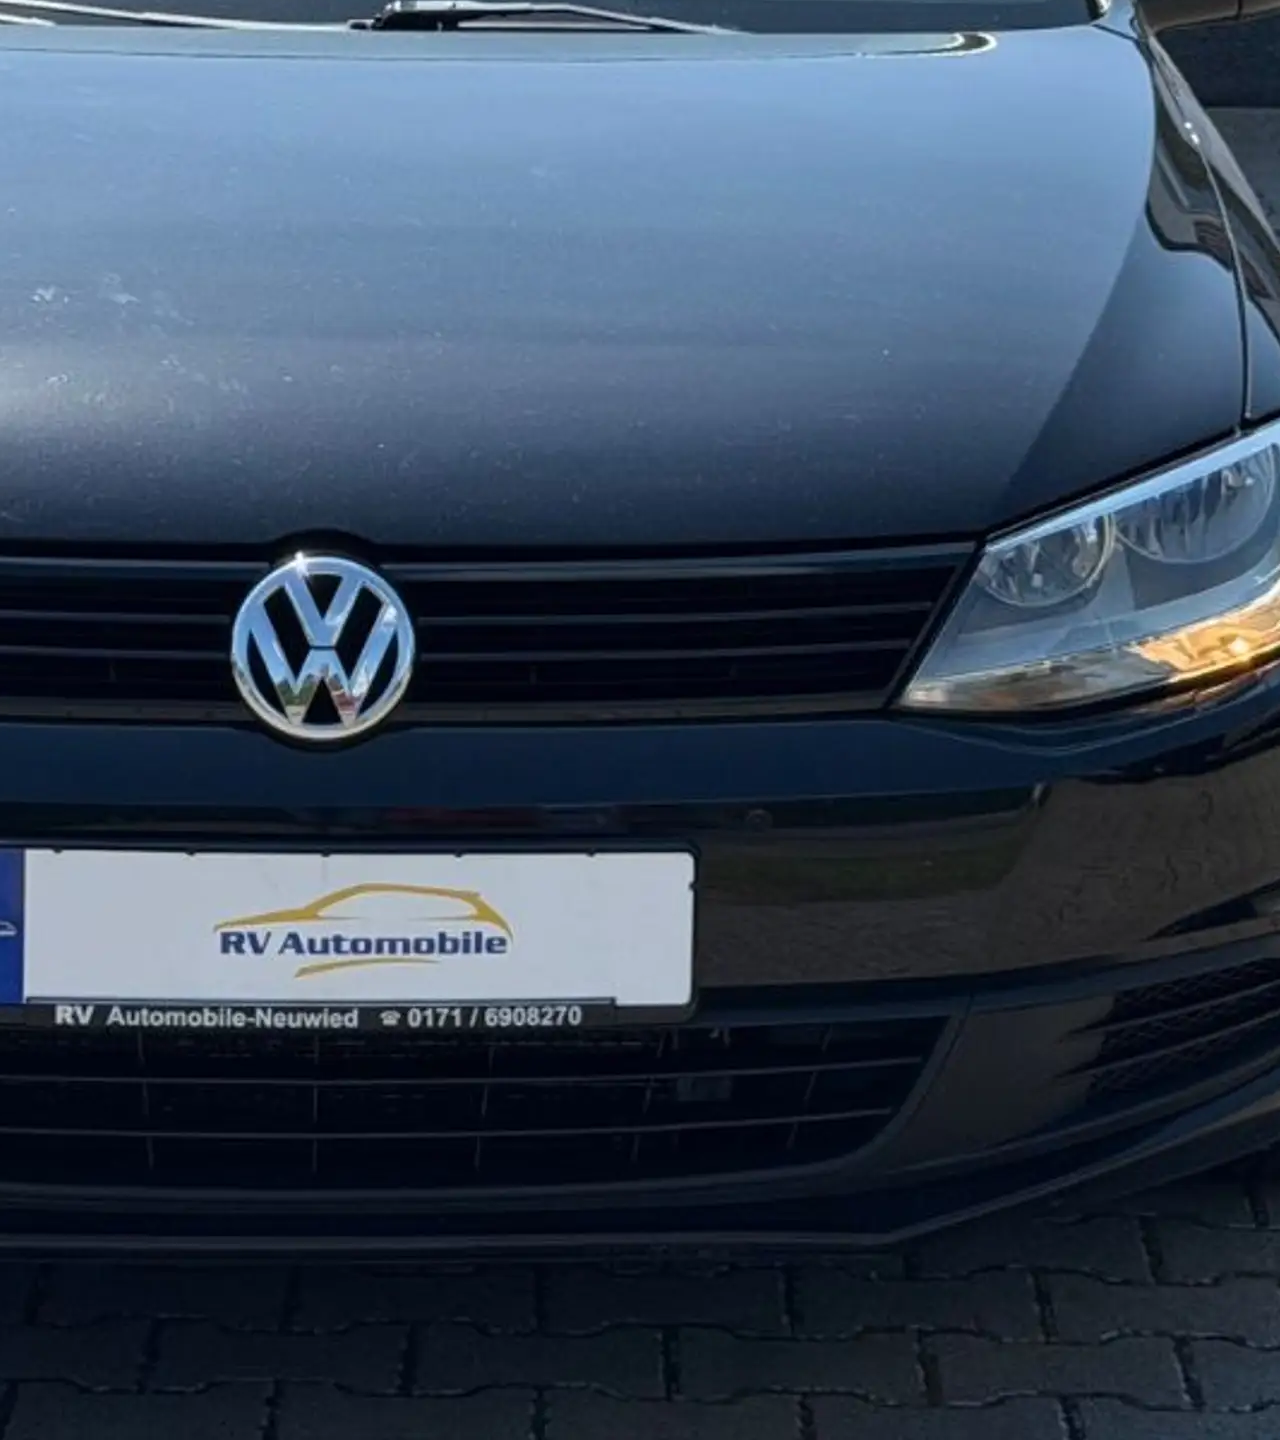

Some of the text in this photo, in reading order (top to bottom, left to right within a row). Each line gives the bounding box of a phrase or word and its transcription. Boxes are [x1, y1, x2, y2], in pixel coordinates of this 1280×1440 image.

[219, 931, 508, 955] RV Automobile
[54, 1005, 582, 1028] RV Automobile-Neuwied 0171 / 6908270
